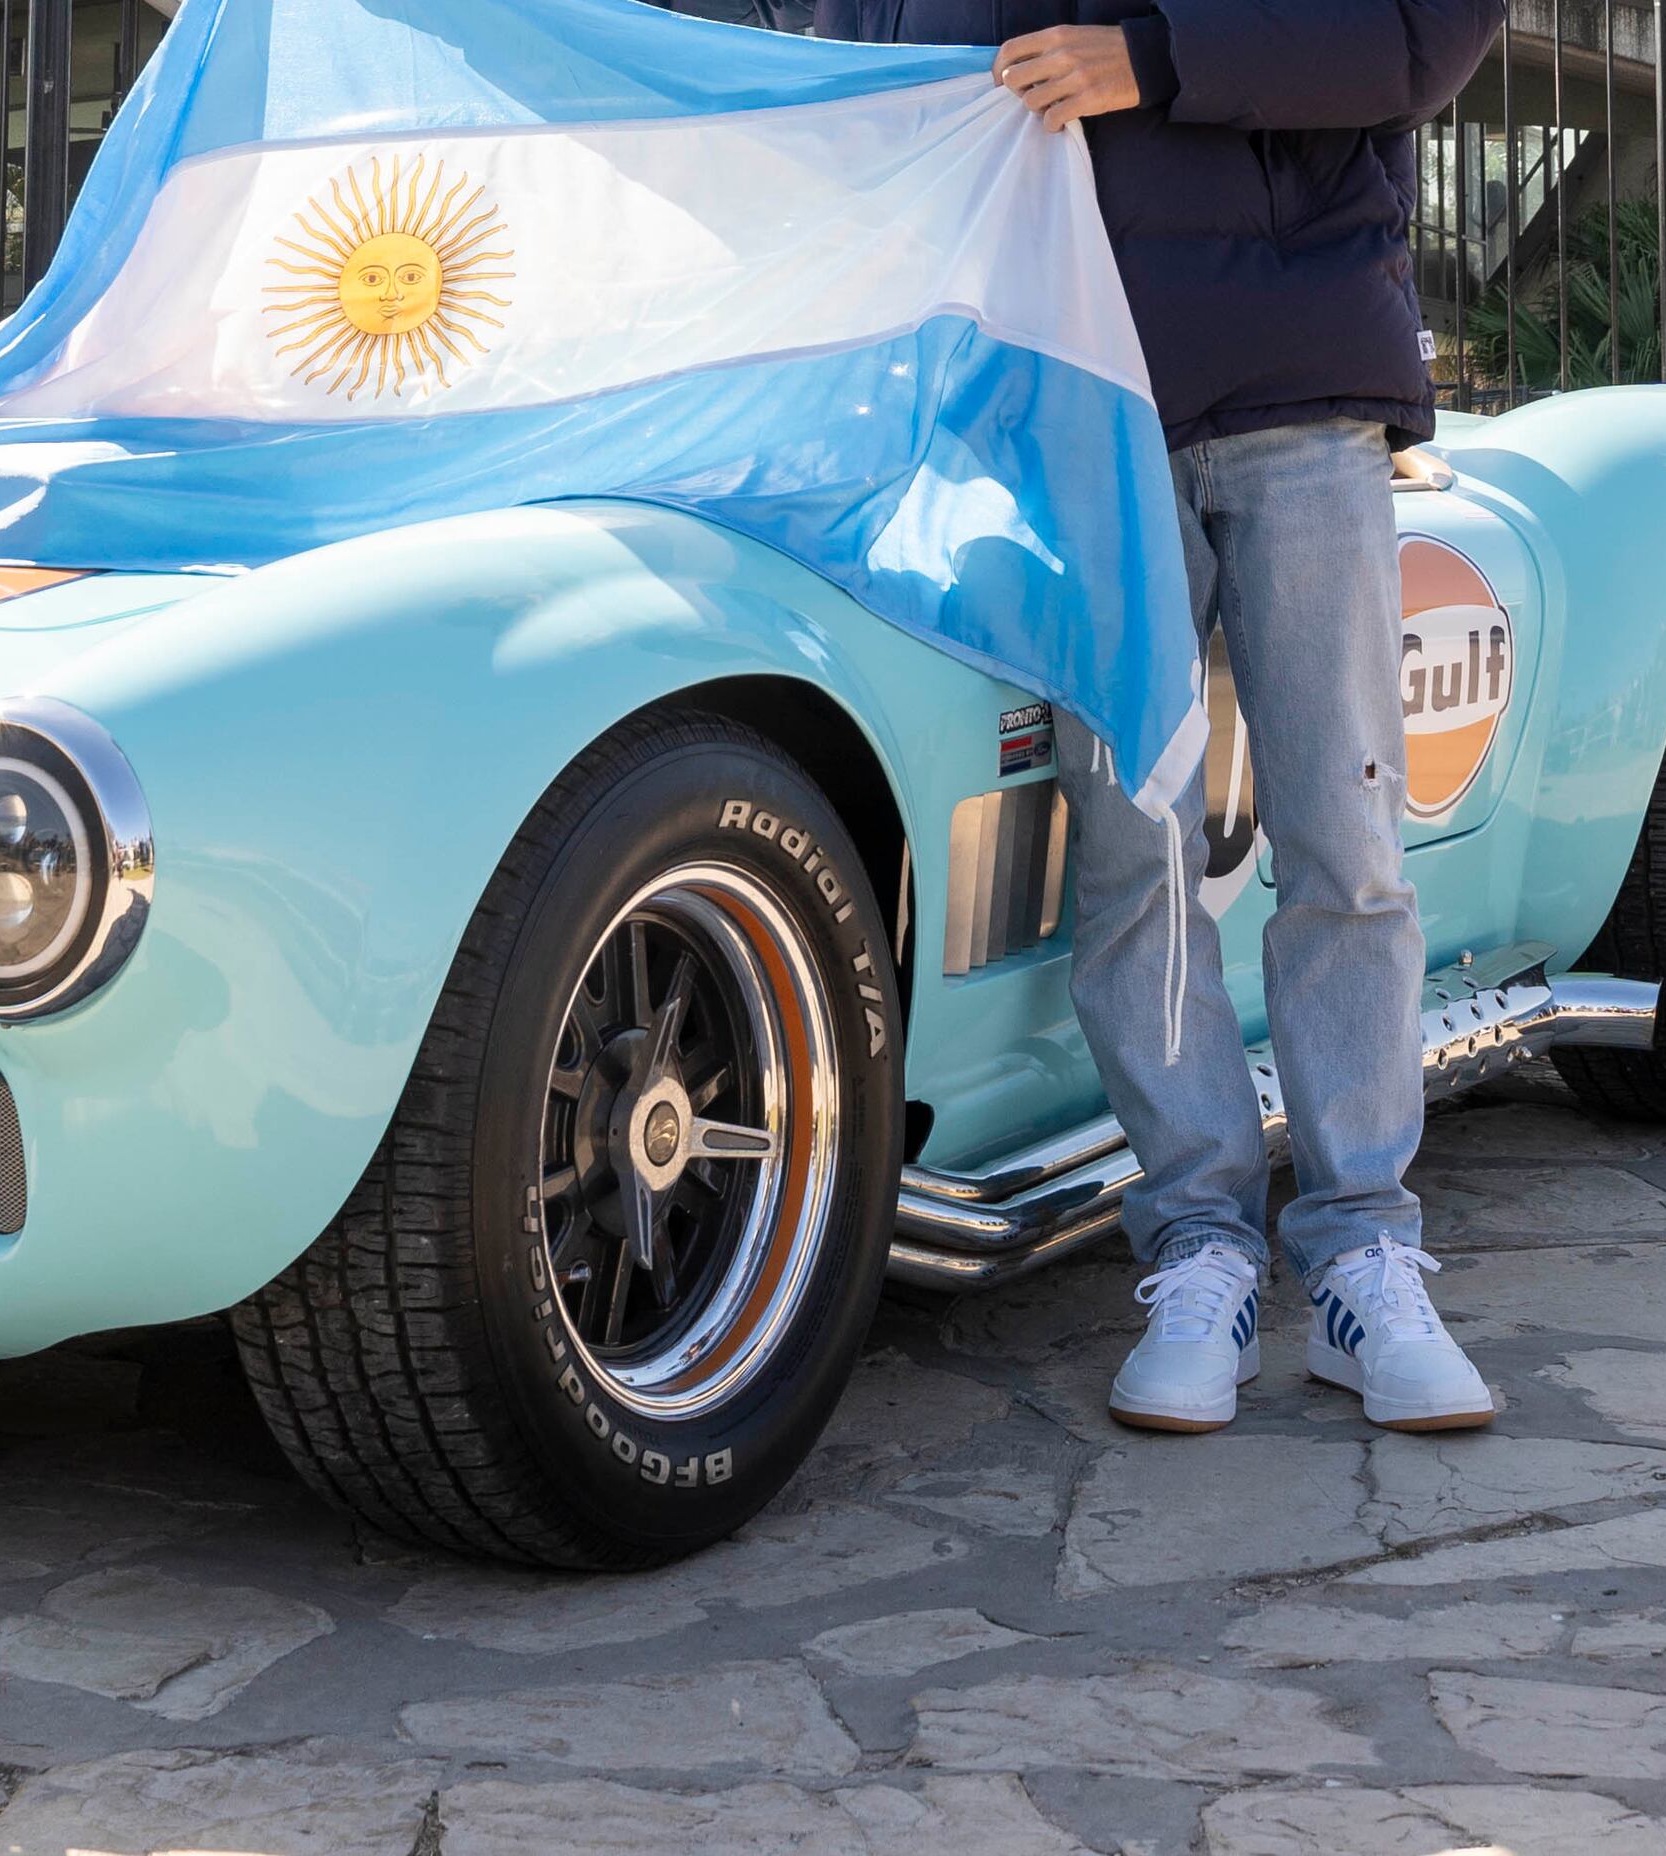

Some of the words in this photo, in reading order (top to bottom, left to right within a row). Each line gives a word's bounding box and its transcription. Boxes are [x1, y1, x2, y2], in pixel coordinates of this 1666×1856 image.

[1401, 624, 1506, 718] Gulf
[718, 798, 854, 924] Radial
[851, 938, 887, 1058] T/A
